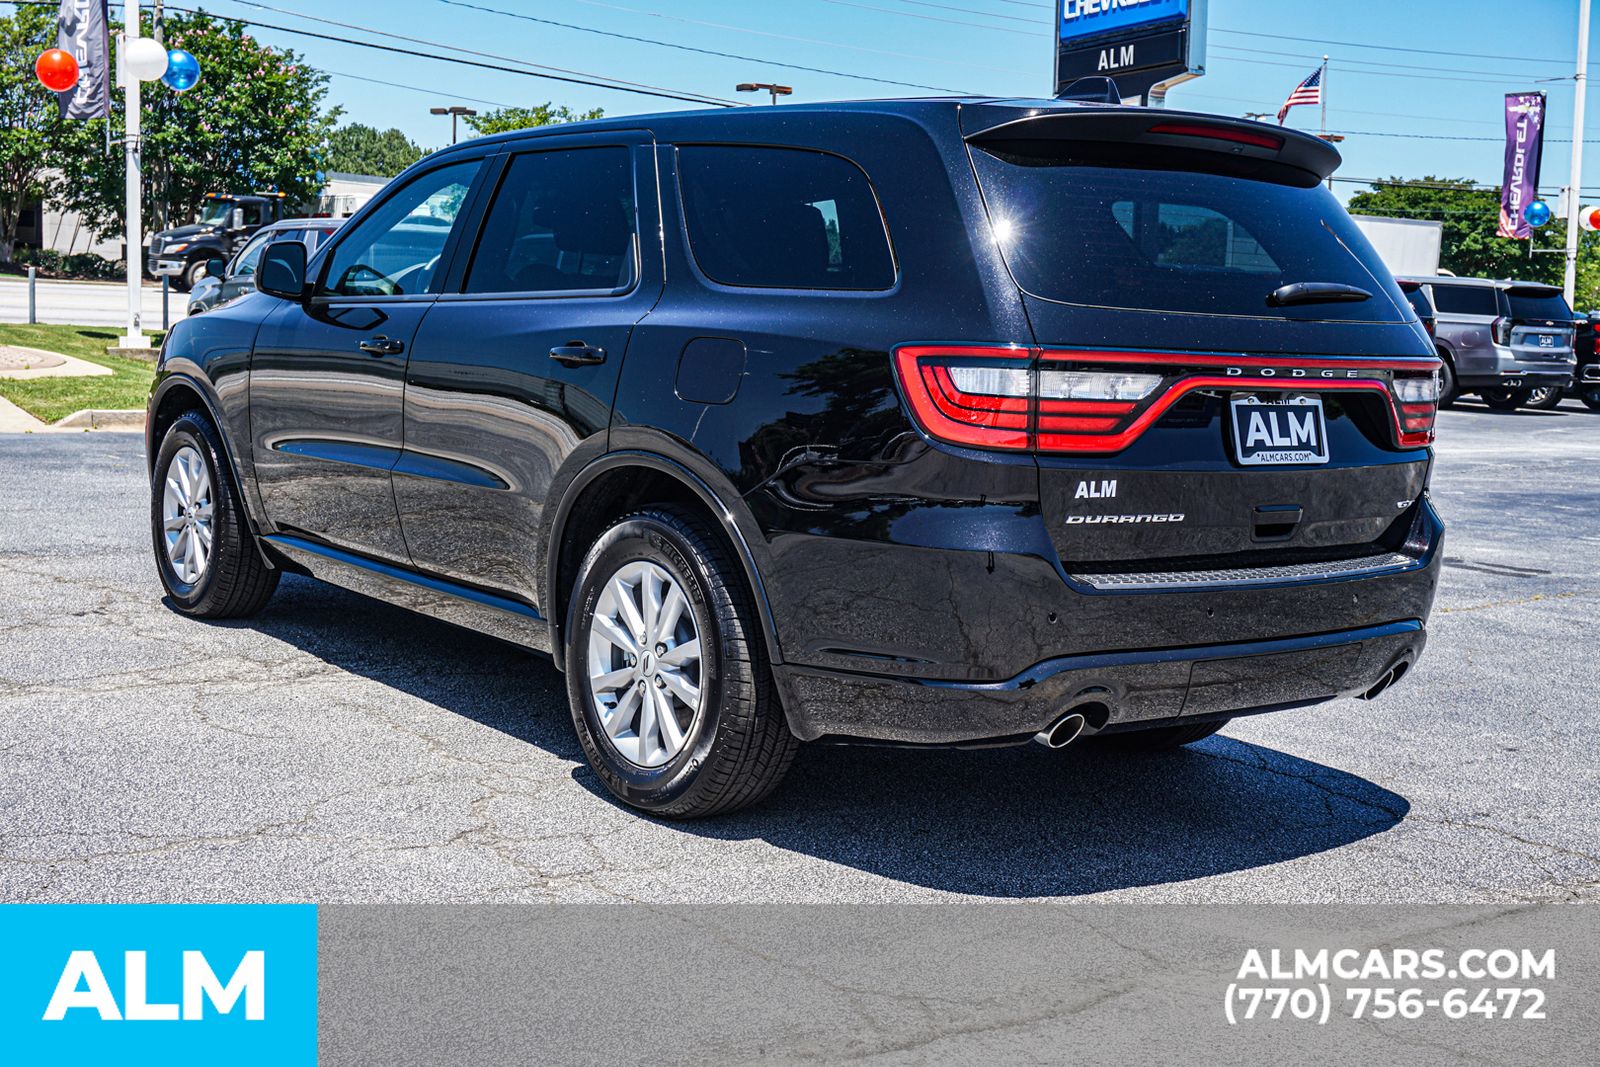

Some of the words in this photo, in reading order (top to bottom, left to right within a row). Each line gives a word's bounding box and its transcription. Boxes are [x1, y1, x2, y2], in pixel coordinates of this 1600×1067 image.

[1098, 44, 1134, 71] ALM
[1226, 367, 1358, 378] DODGE
[1245, 411, 1317, 448] ALM
[1260, 452, 1310, 462] ALMCARS.COM
[1074, 479, 1117, 499] ALM
[1065, 513, 1185, 524] DURANGO
